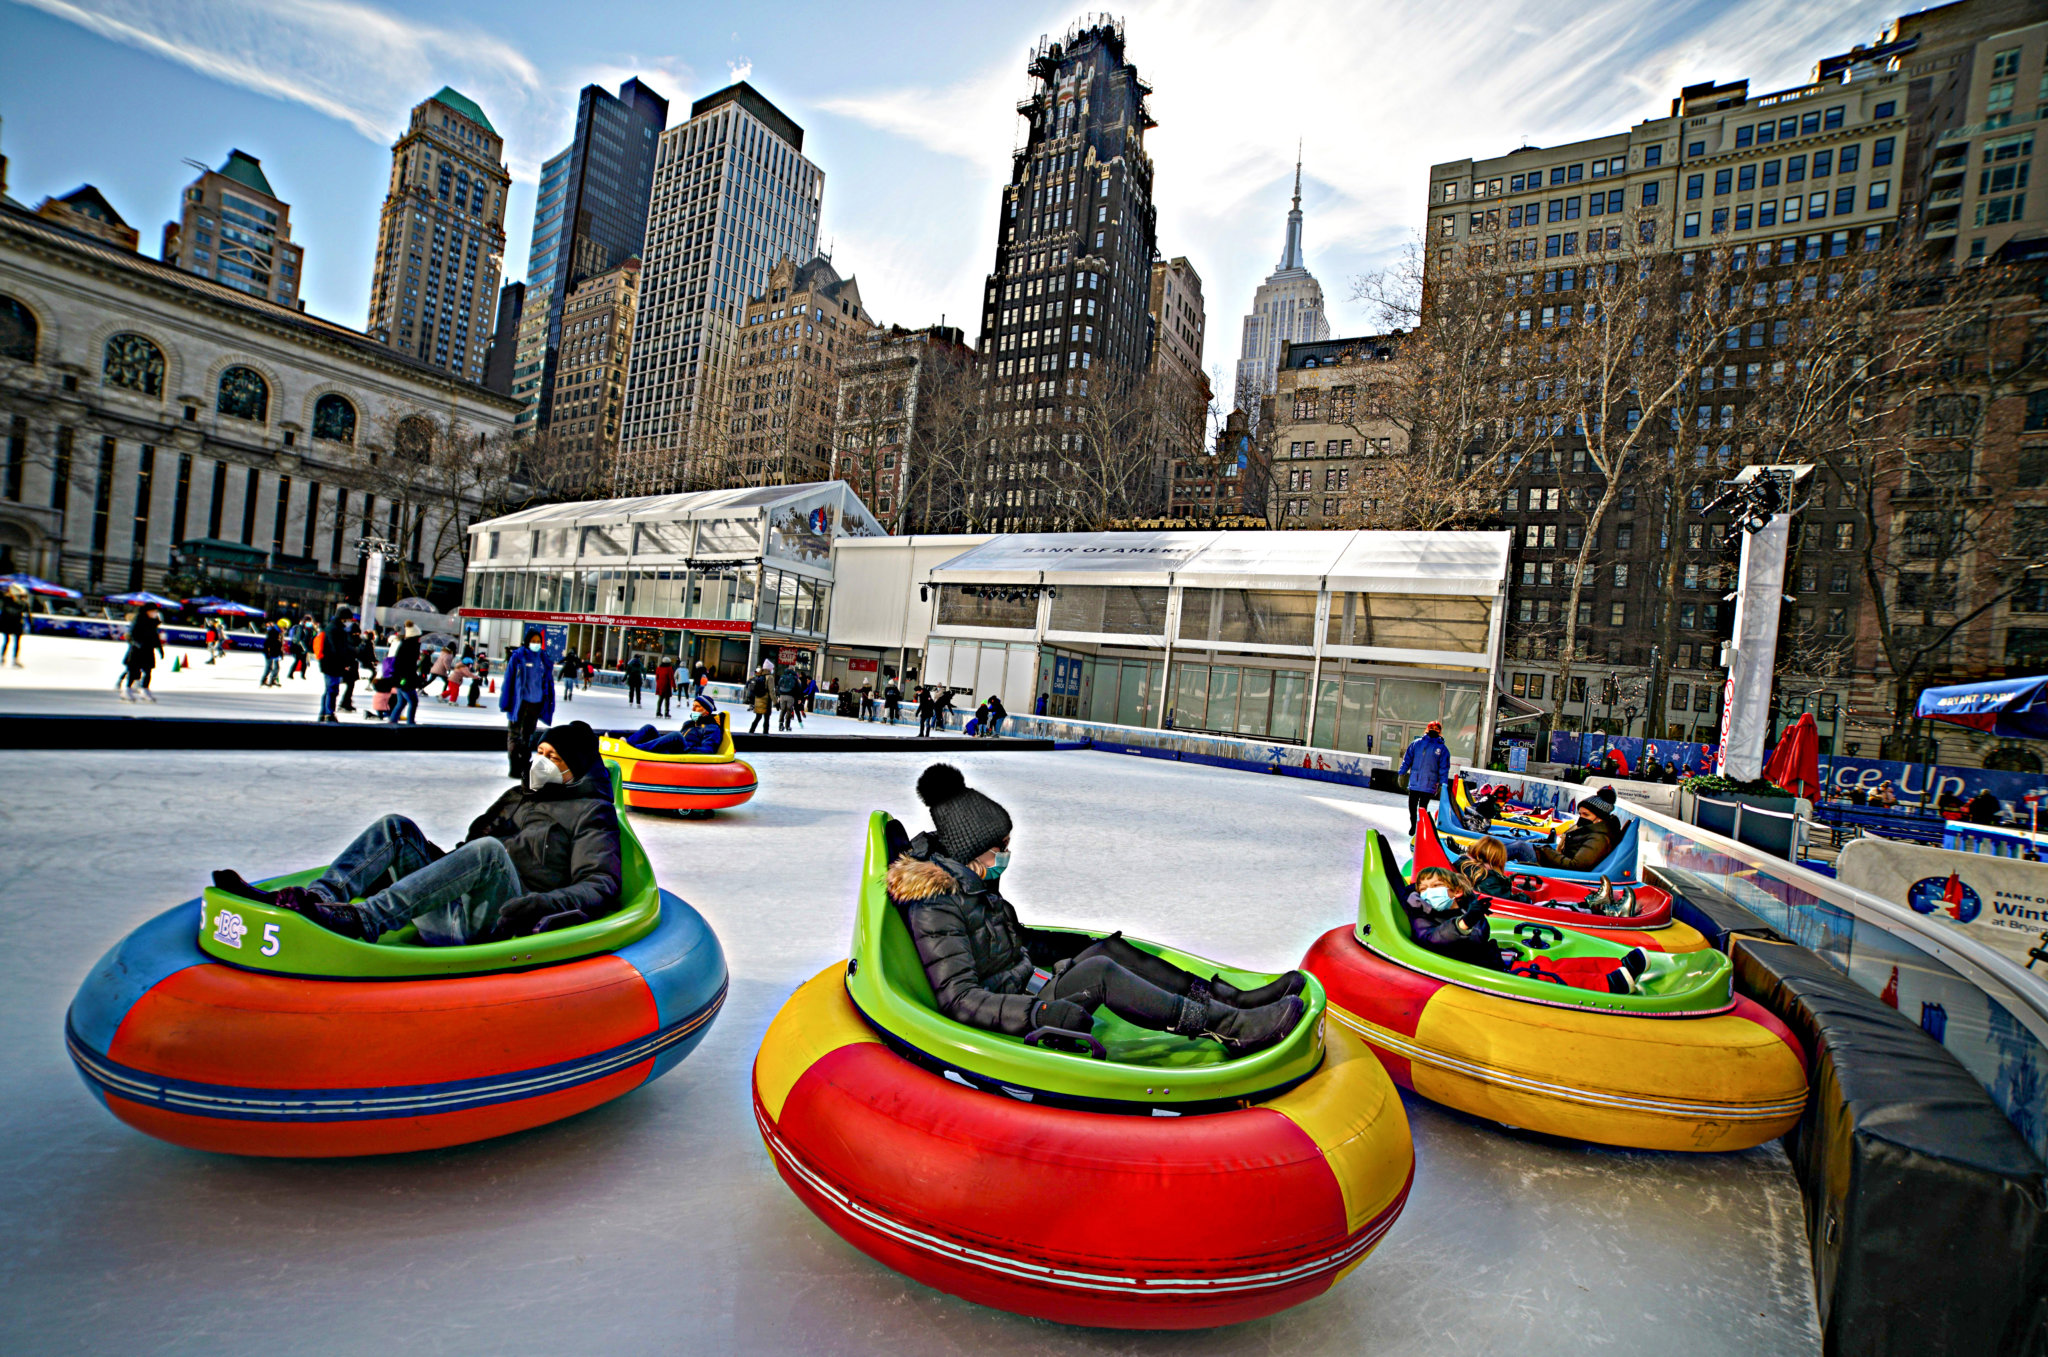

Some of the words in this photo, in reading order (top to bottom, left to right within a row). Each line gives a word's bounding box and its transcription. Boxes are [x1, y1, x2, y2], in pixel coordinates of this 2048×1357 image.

[600, 615, 615, 625] Village
[1995, 890, 2032, 902] BANK
[2035, 896, 2048, 904] O
[259, 923, 280, 957] 5
